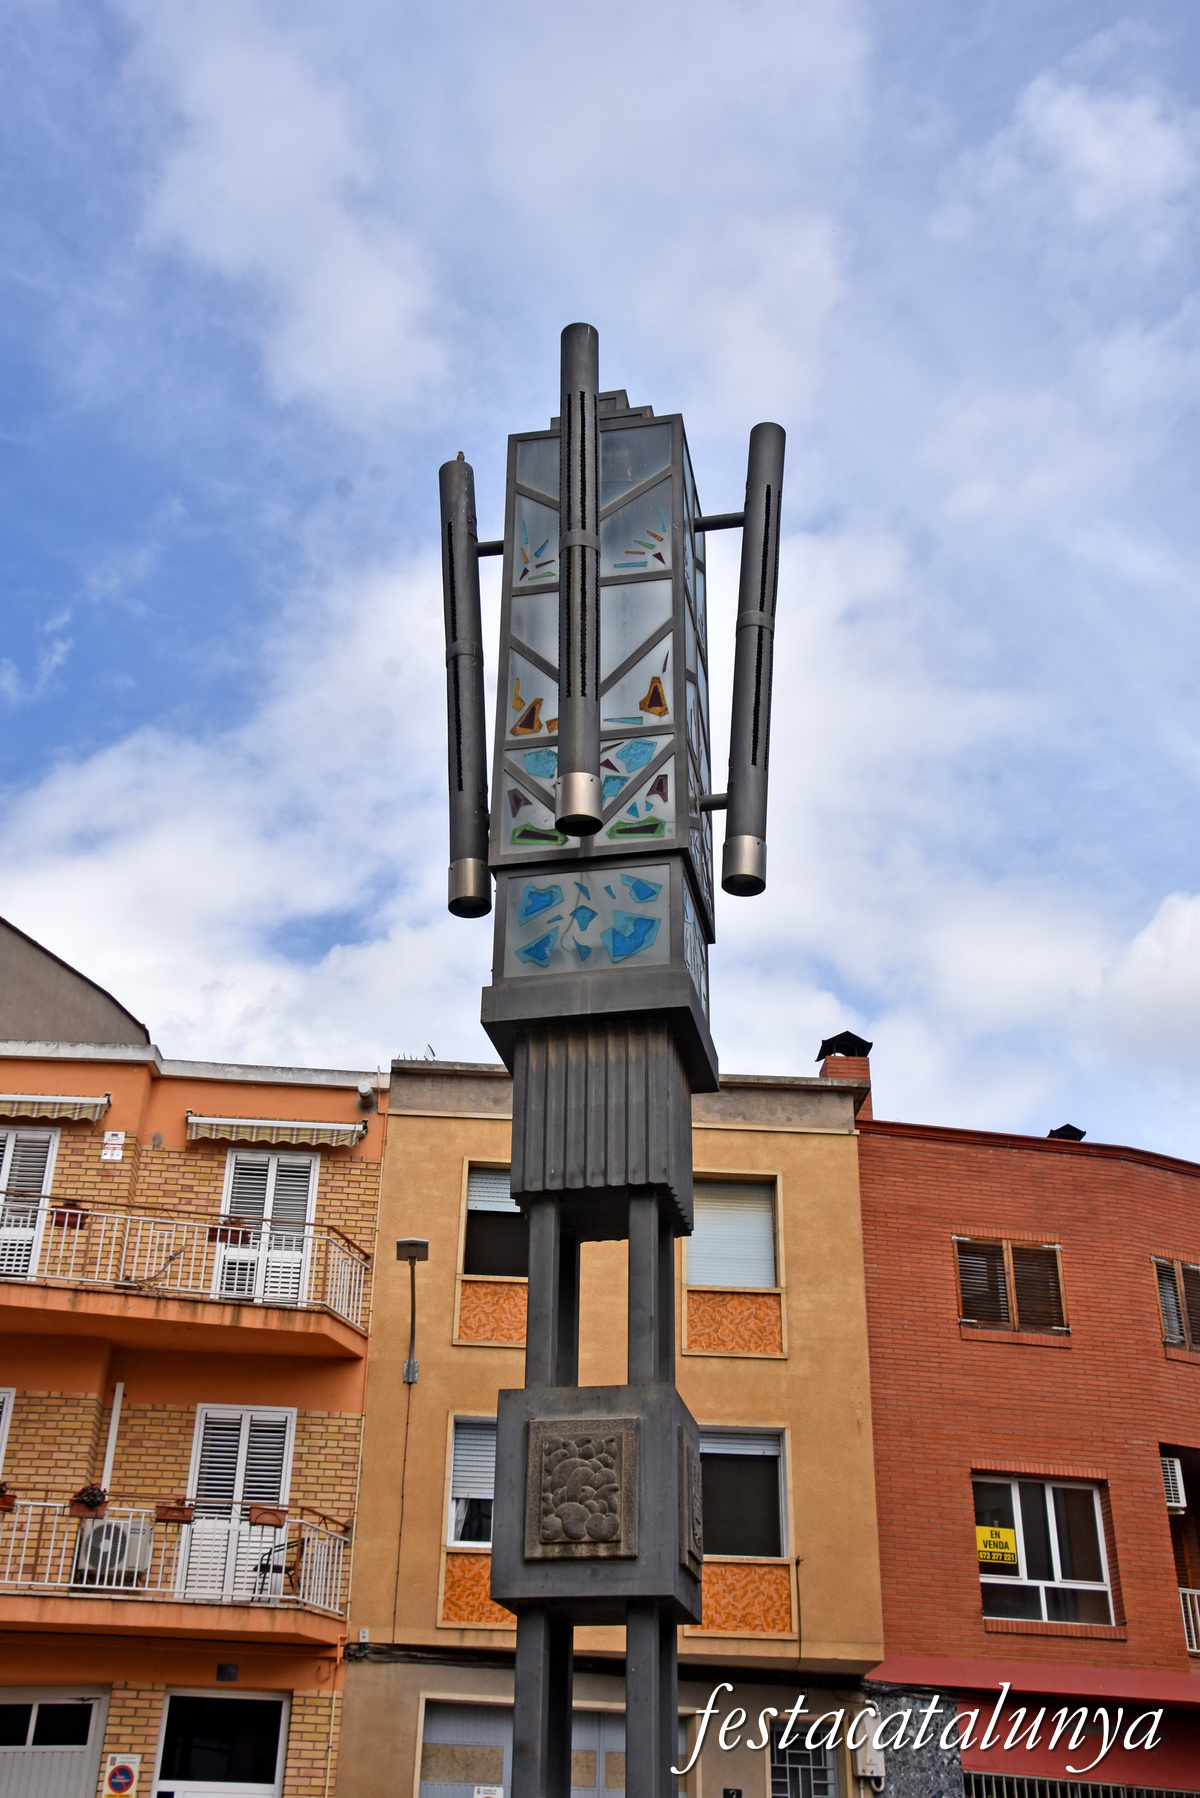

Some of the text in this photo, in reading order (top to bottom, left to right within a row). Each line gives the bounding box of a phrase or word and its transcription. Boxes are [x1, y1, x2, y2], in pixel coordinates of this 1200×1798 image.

[990, 1530, 1000, 1539] EN
[983, 1540, 1009, 1550] VENDA
[991, 1553, 1002, 1561] 377
